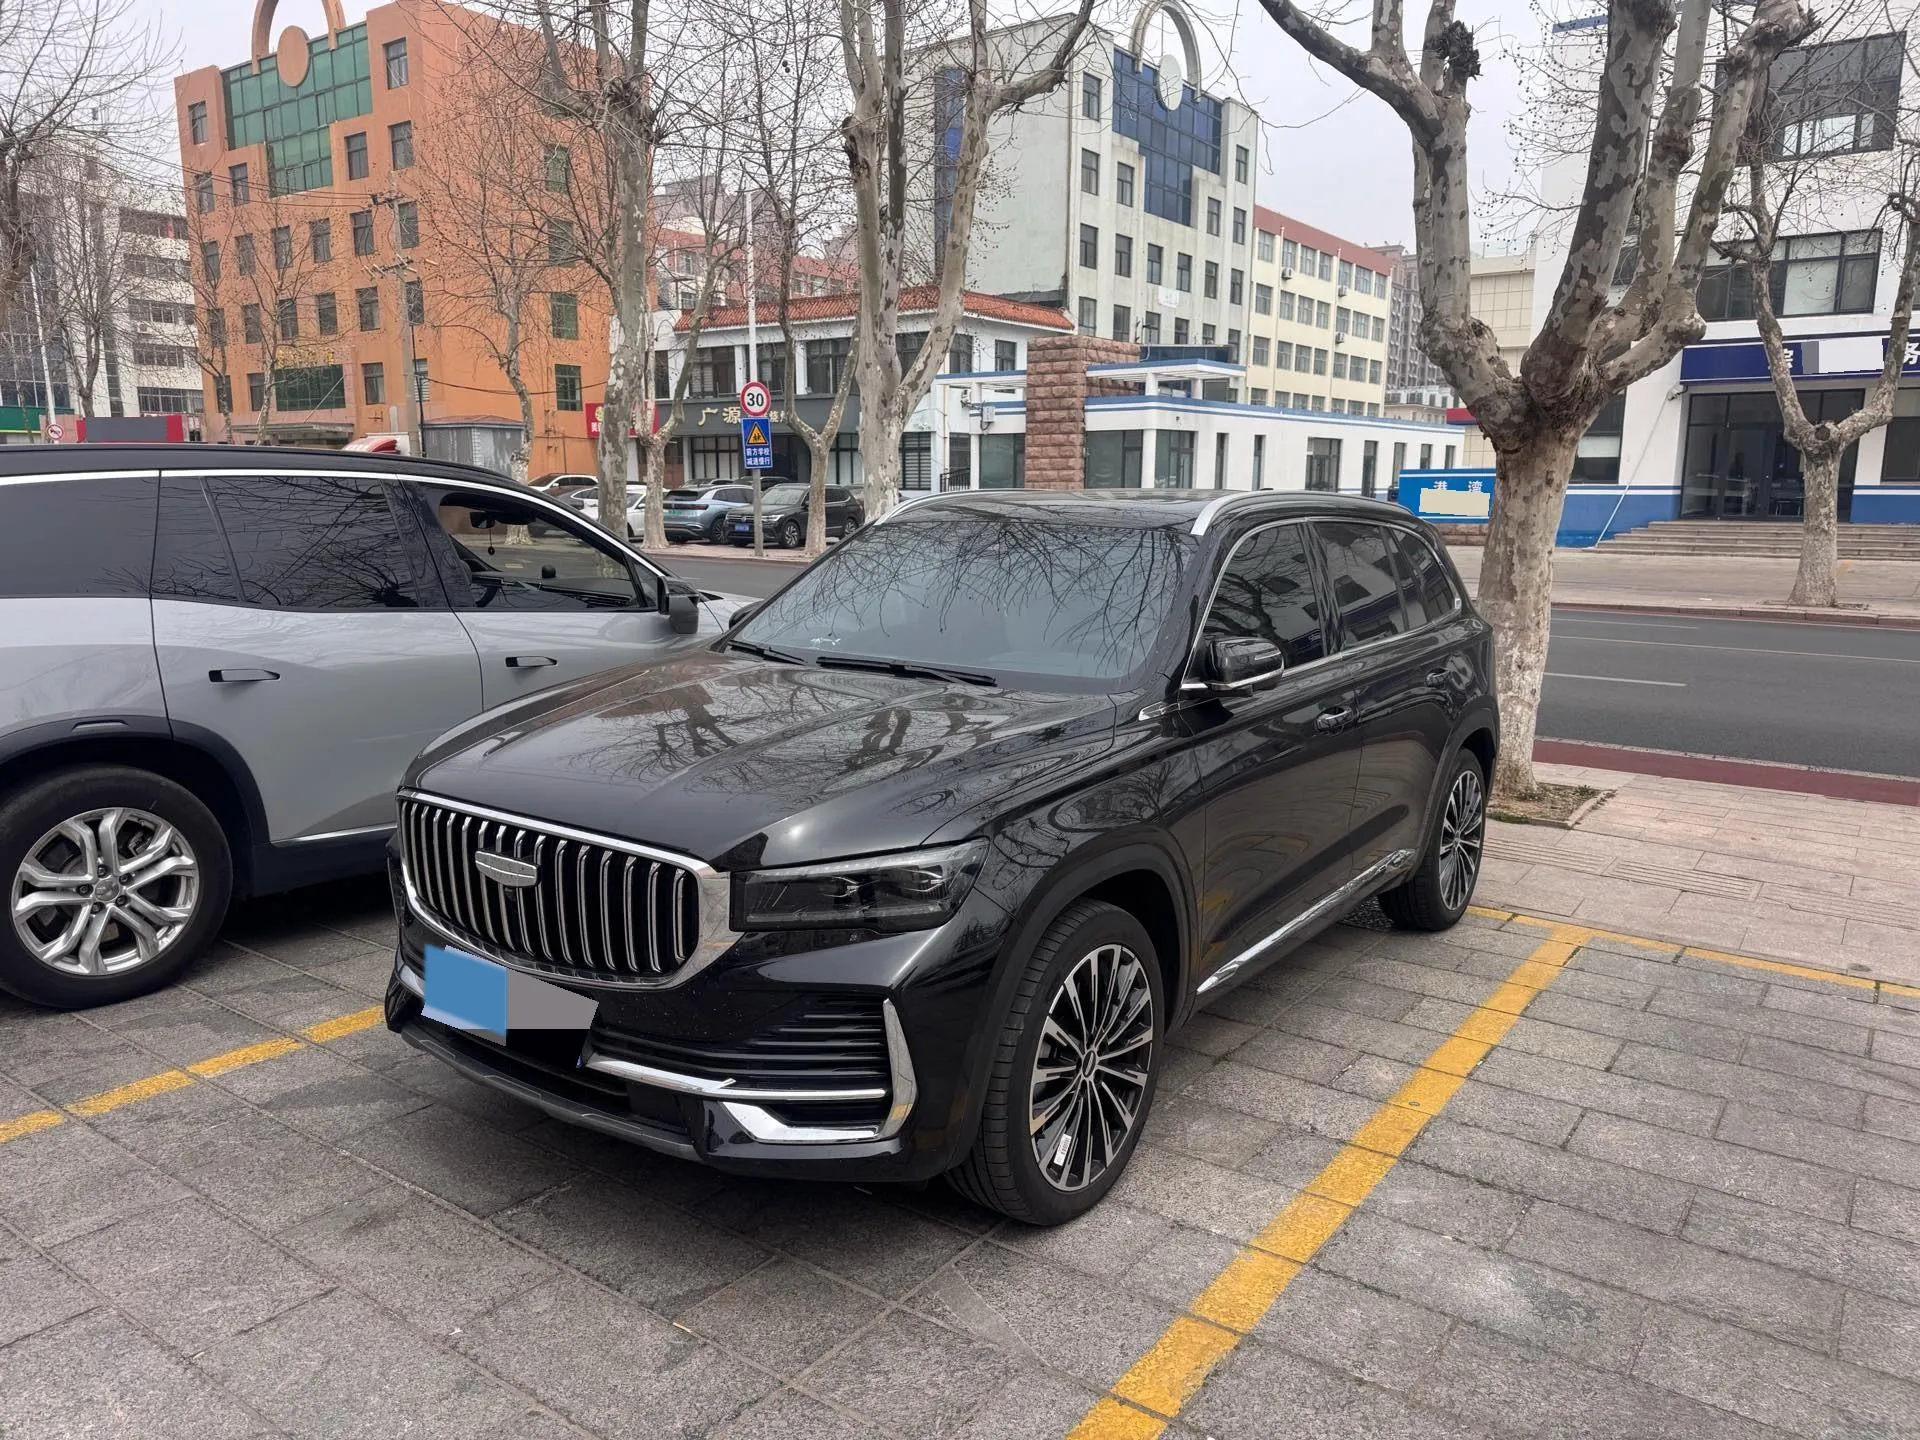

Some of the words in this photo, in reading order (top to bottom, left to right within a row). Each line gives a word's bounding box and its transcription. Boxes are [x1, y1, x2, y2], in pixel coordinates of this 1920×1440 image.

[746, 392, 764, 407] 30
[698, 406, 741, 426] 广源
[746, 447, 770, 457] 前方学校
[746, 456, 770, 466] 减速慢行
